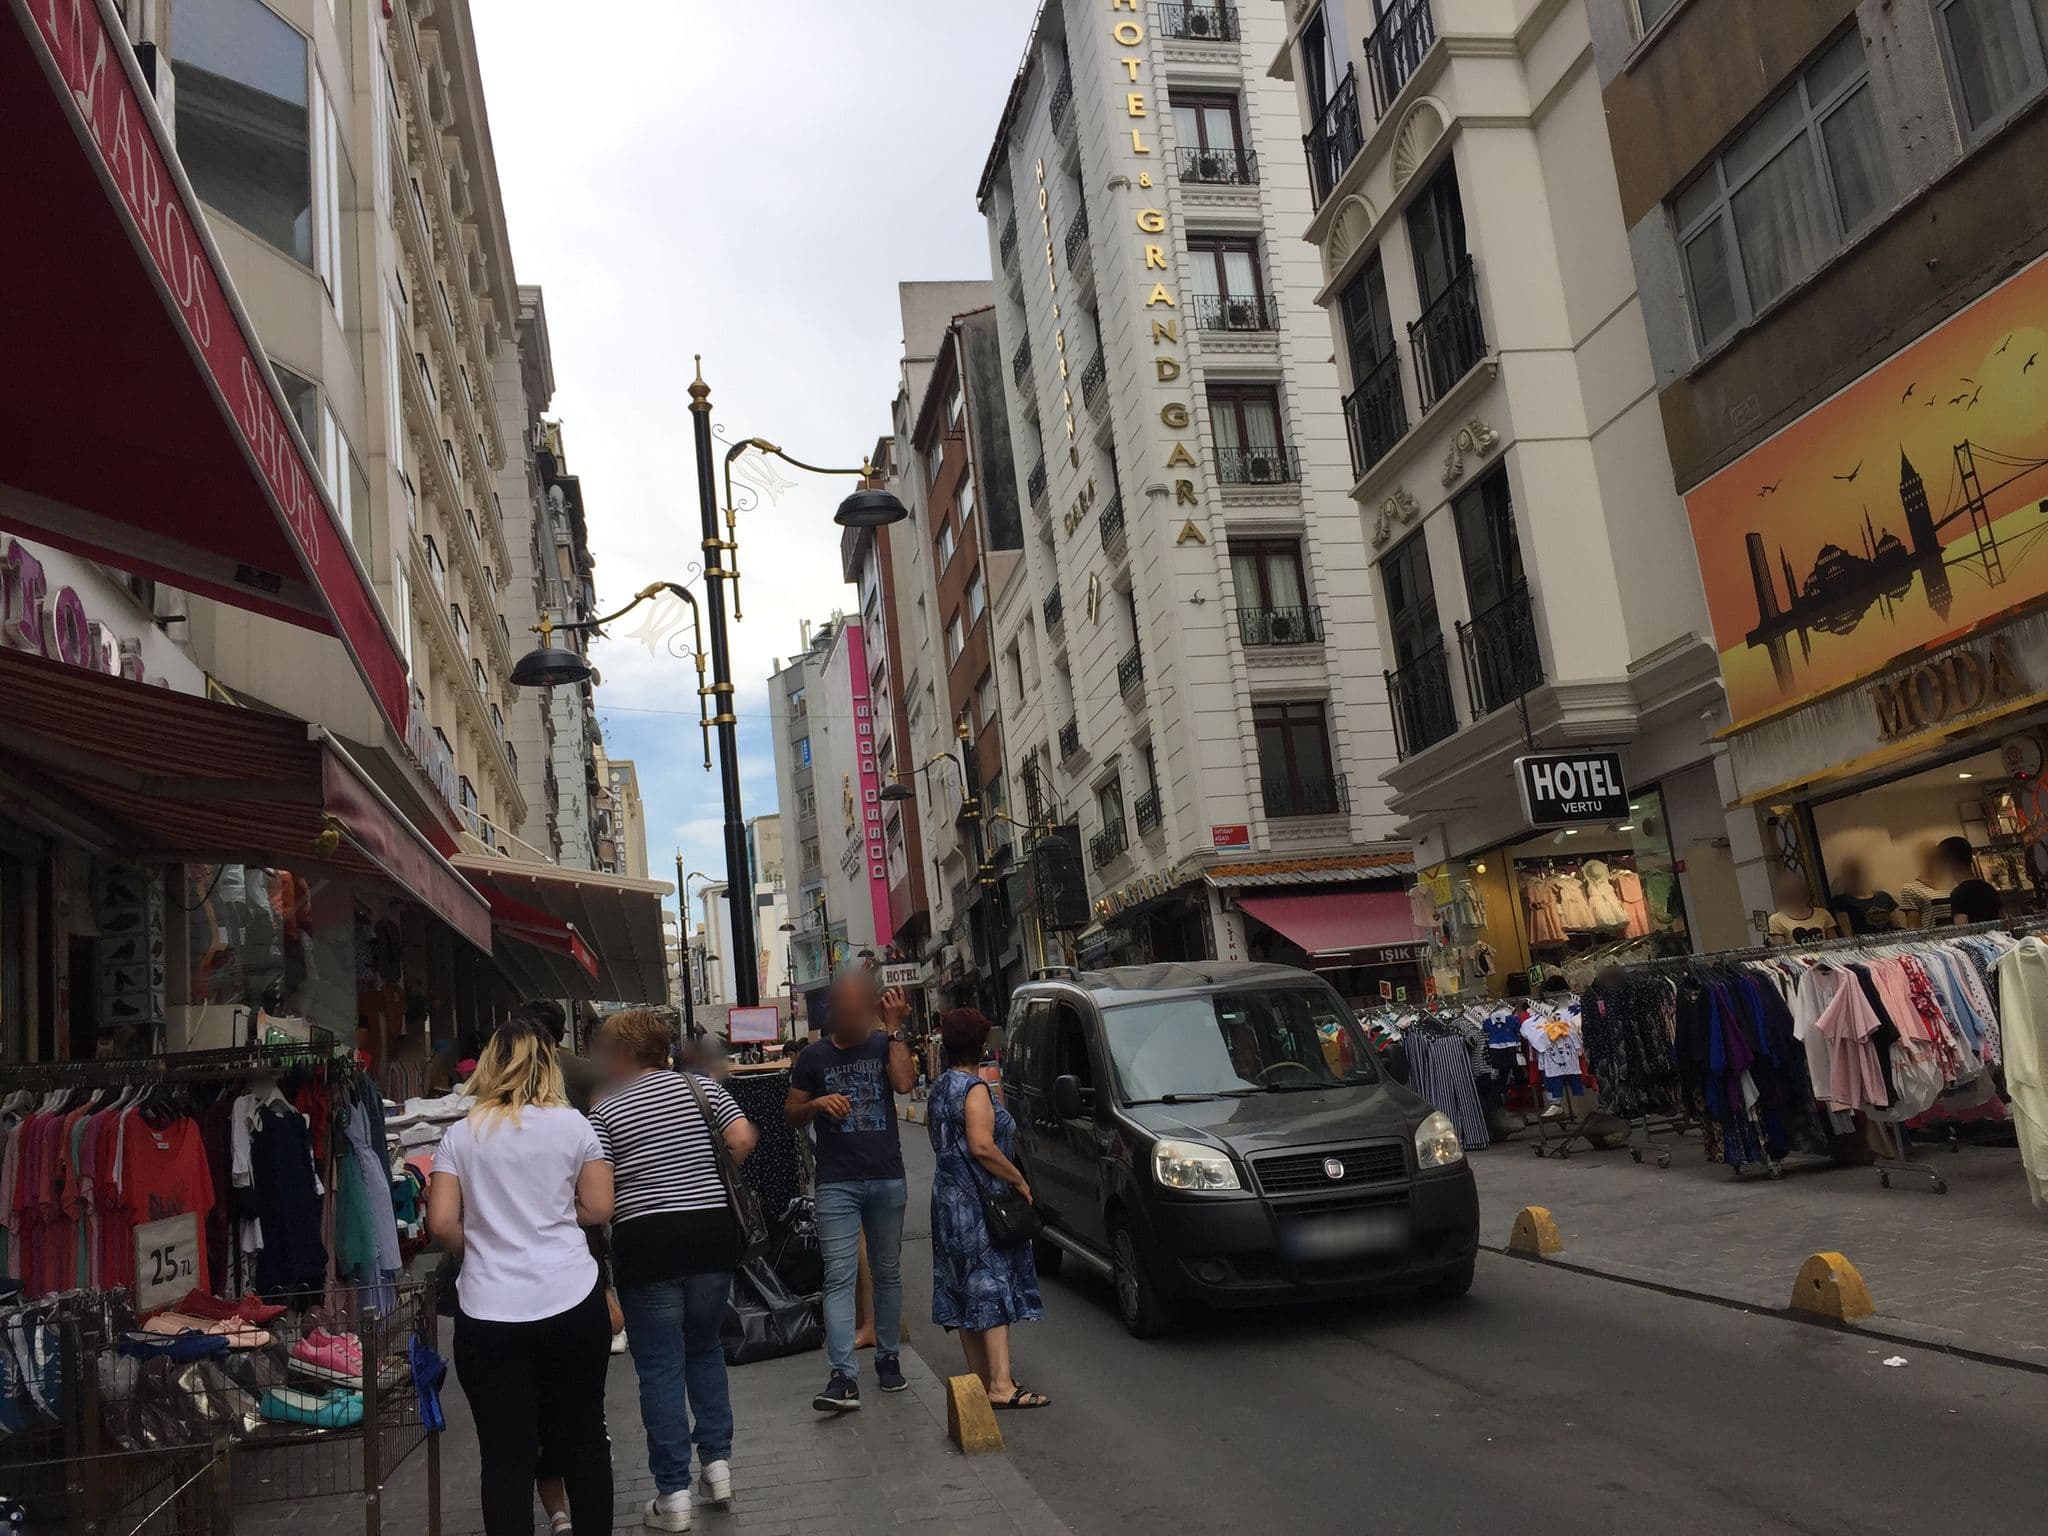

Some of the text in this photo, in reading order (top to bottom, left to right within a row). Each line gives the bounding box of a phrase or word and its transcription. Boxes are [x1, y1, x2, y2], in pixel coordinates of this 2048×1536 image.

[1139, 172, 1152, 188] &
[1036, 158, 1058, 292] HOTEL
[1056, 329, 1079, 469] GRAND
[1136, 207, 1181, 382] GRAND
[242, 356, 320, 566] SHOES
[1160, 402, 1206, 545] GARA
[1866, 635, 2032, 743] MODA
[853, 695, 886, 878] DOSSO DOSSI
[1531, 760, 1621, 800] HOTEL
[612, 784, 623, 830] GRAND
[1561, 801, 1603, 813] VERTU
[885, 968, 920, 983] HOTEL
[1380, 948, 1410, 963] IŞIK
[151, 1246, 192, 1287] 25 TL
